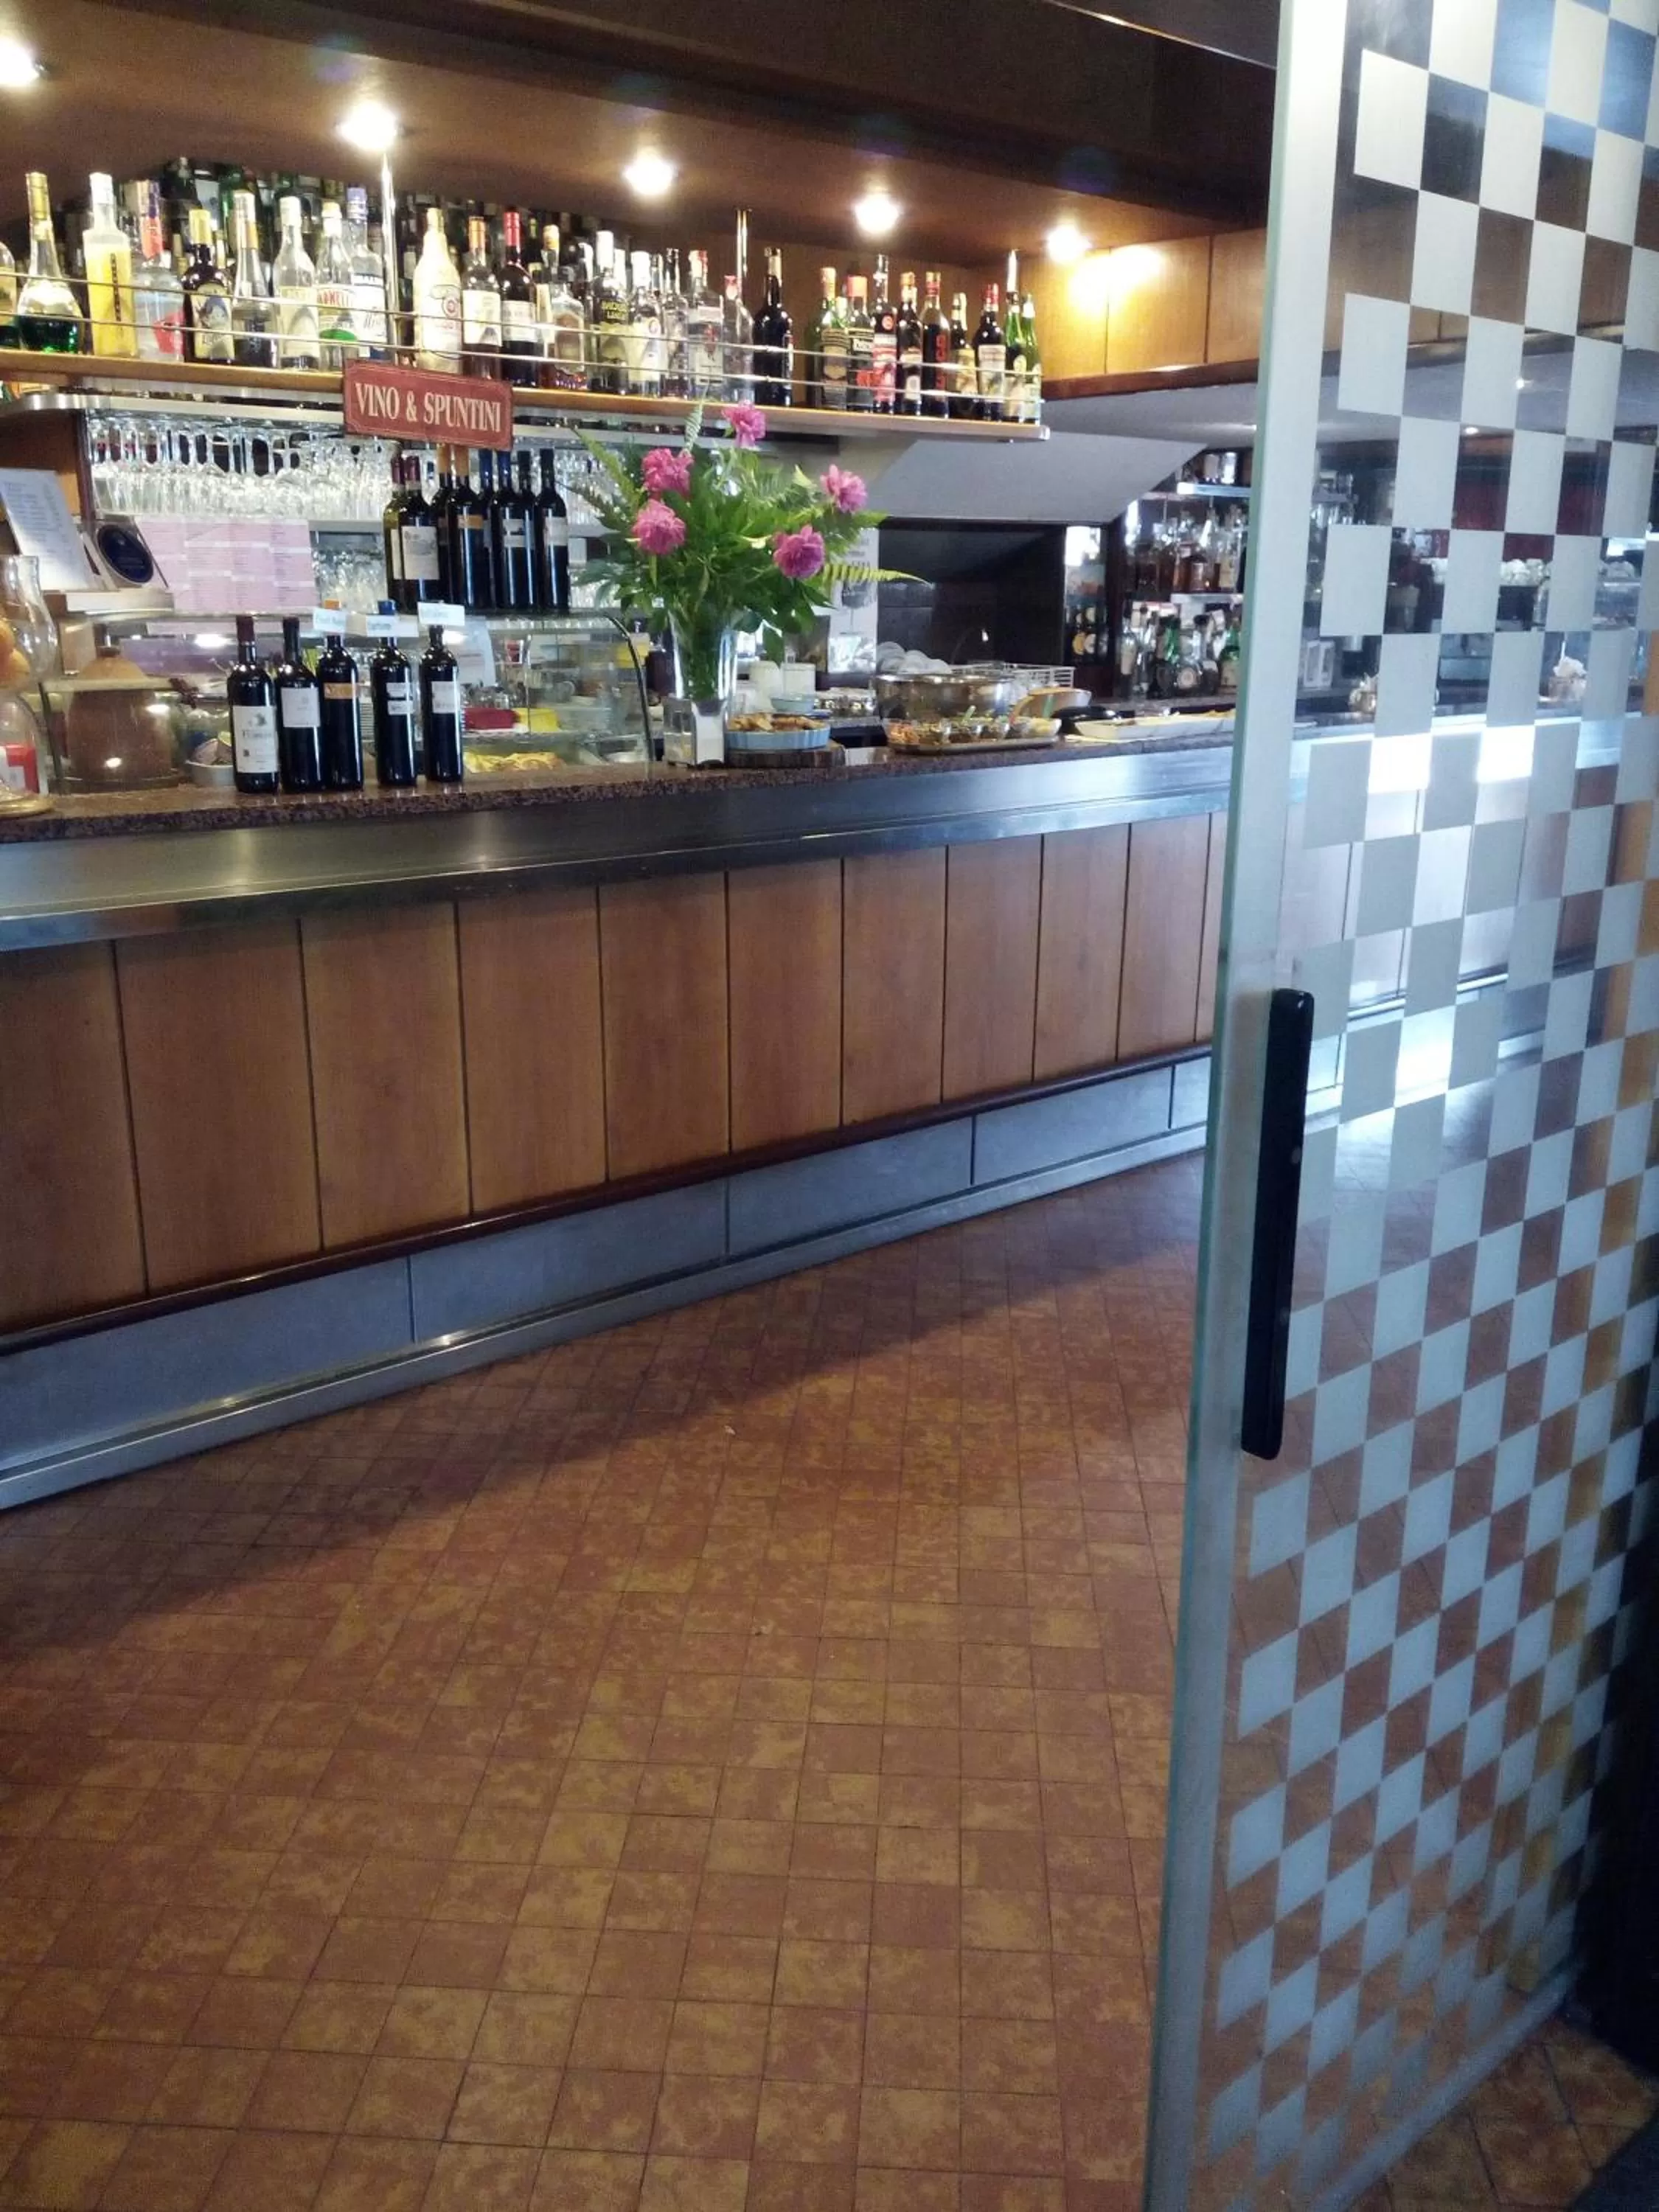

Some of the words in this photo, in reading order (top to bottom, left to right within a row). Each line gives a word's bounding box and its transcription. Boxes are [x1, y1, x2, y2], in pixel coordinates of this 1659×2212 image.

[355, 383, 400, 420] VINO
[406, 391, 417, 422] &
[423, 392, 501, 432] SPUNTINI
